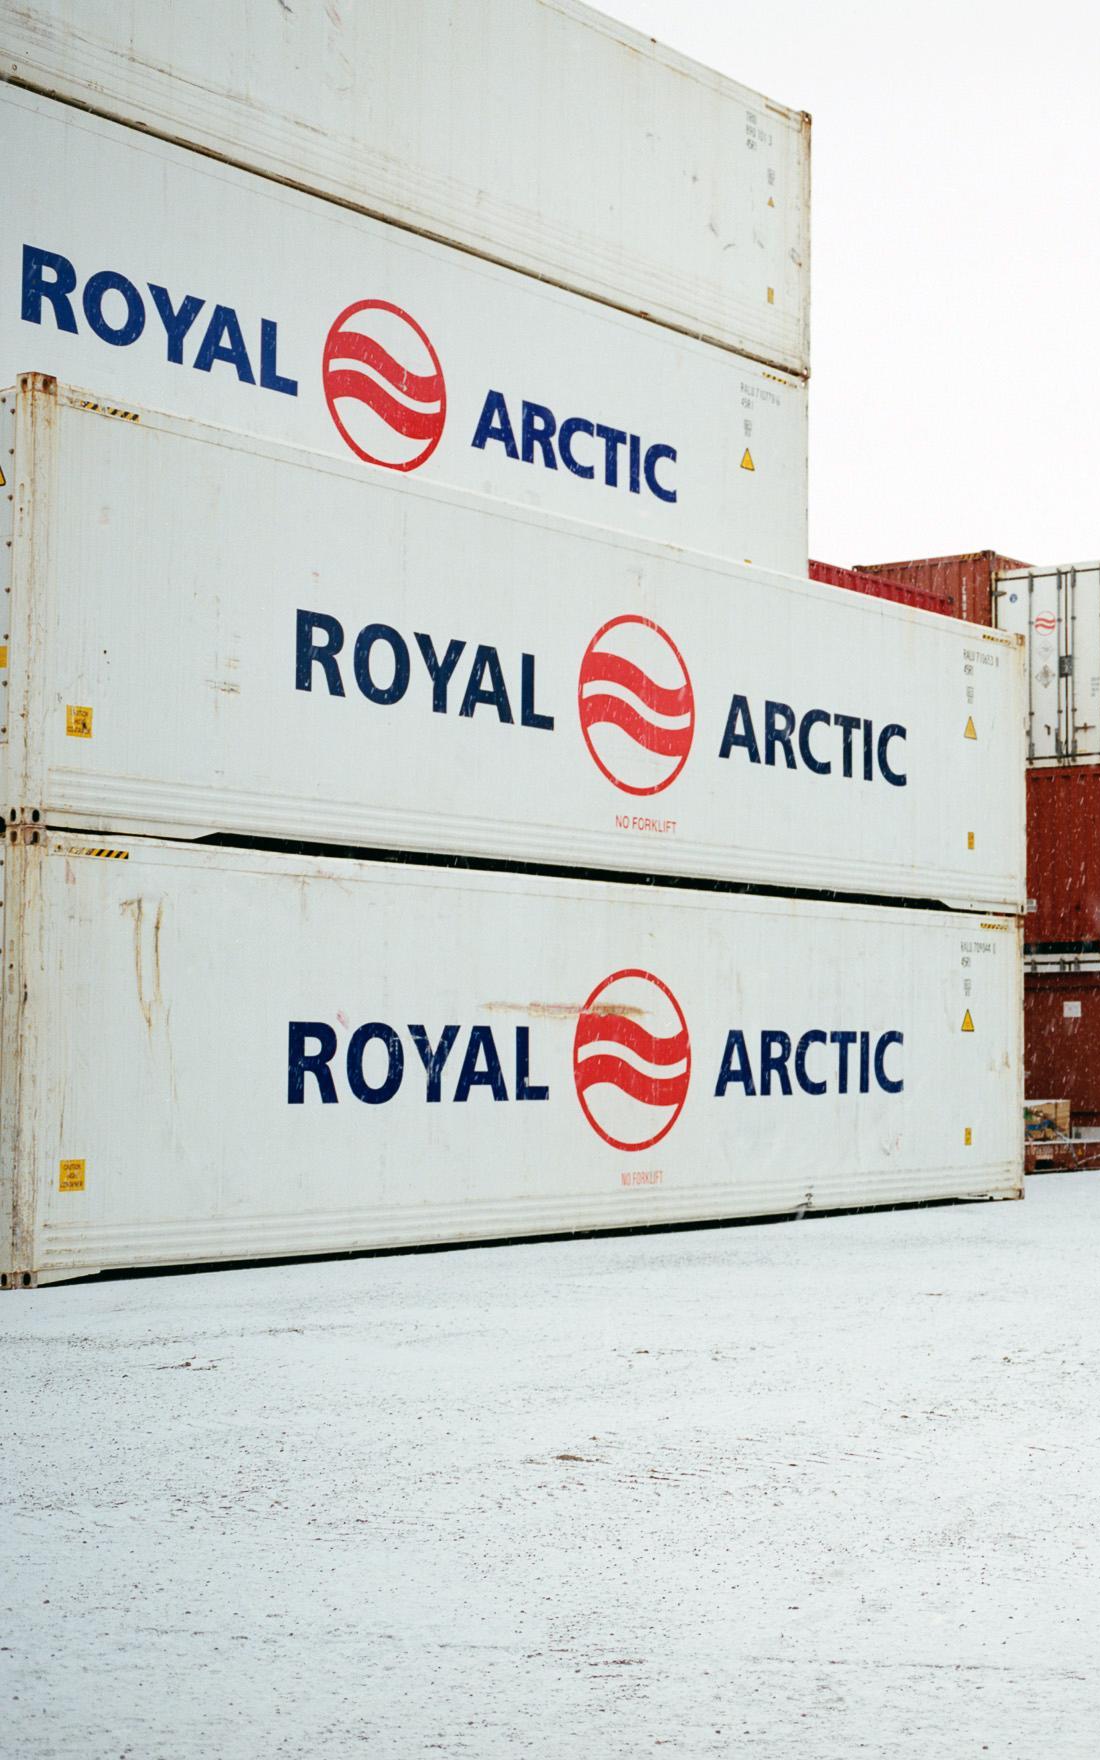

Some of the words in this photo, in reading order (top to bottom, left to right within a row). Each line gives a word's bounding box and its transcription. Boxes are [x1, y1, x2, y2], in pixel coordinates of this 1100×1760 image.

[21, 244, 298, 396] ROYAL
[471, 390, 677, 503] ARCTIC
[296, 609, 554, 730] ROYAL
[719, 694, 907, 786] ARCTIC
[615, 815, 629, 829] NO
[632, 817, 677, 833] FORKLIFT
[288, 1021, 549, 1104] ROYAL
[714, 1030, 903, 1097] ARCTIC
[632, 1170, 663, 1185] FORKLIFT
